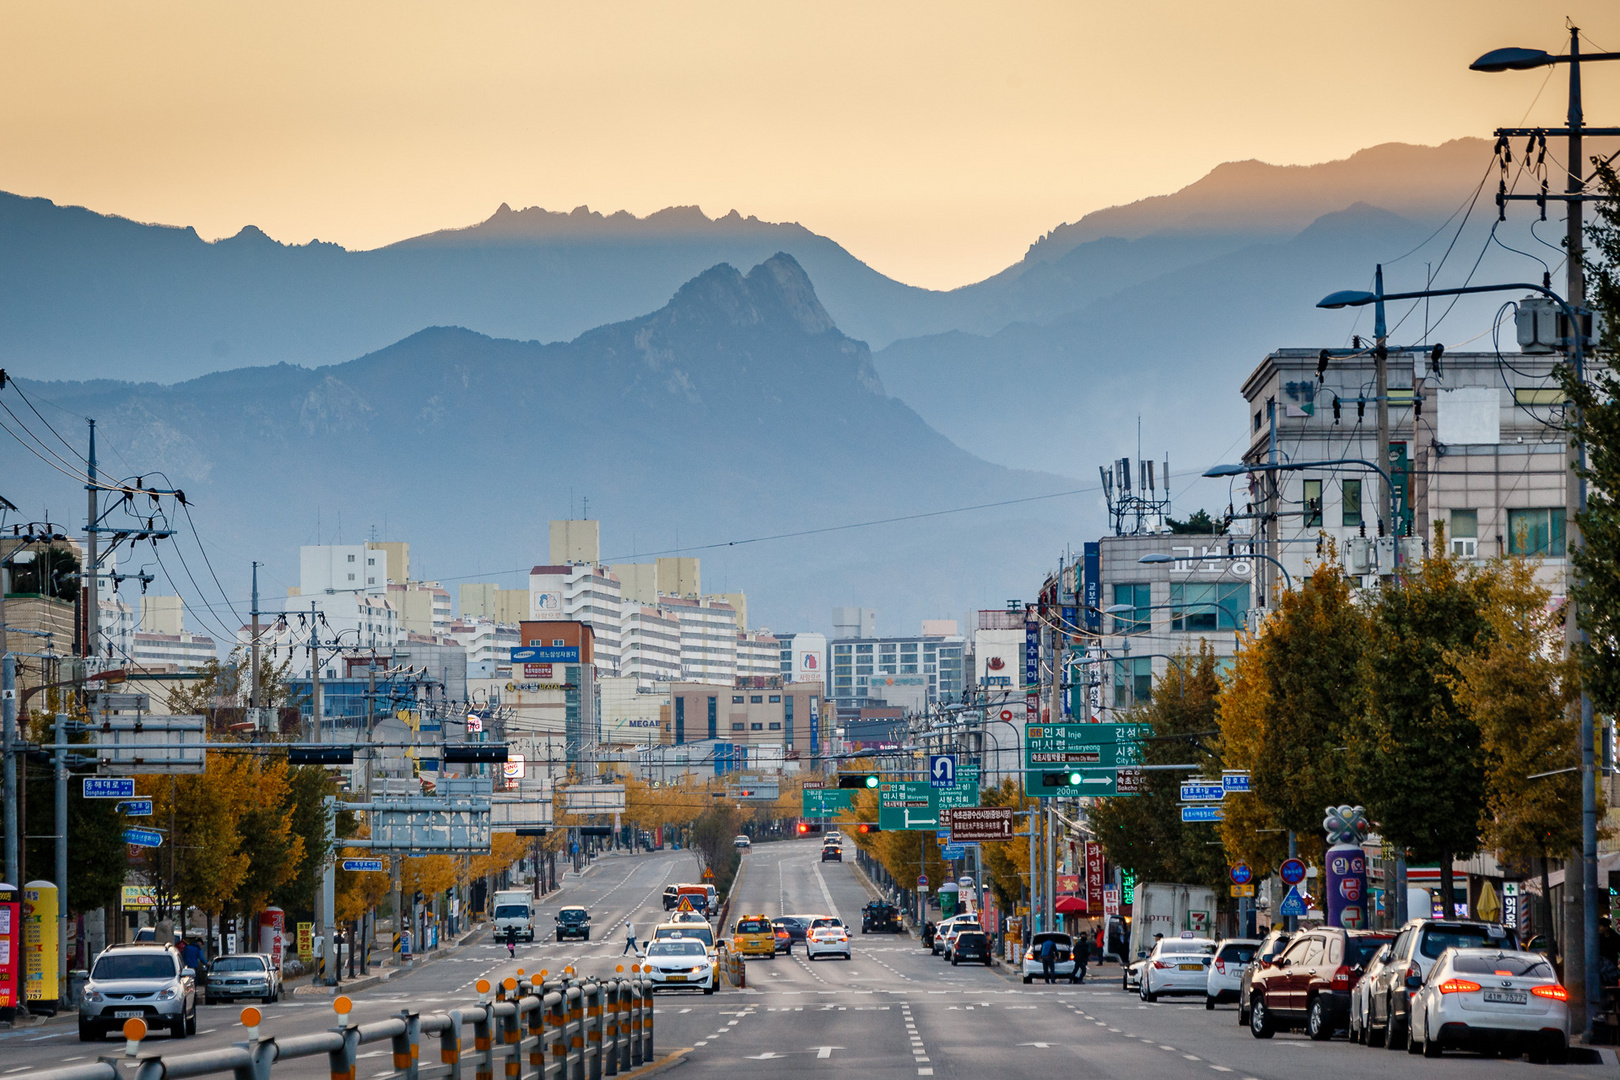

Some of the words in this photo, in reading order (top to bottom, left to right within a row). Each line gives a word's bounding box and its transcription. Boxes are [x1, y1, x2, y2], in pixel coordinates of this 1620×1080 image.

[1027, 633, 1037, 681] 해수피아
[1030, 729, 1042, 737] 56
[1044, 727, 1065, 738] 인제
[1032, 740, 1065, 751] 미시령
[1068, 744, 1100, 752] Misiryeong
[1032, 753, 1066, 762] 속초시립박물관
[86, 781, 119, 790] 동해대로
[1225, 777, 1246, 785] 청호로
[891, 784, 906, 792] 인제
[1057, 788, 1078, 796] 200m
[883, 792, 906, 800] 미시령
[953, 810, 1012, 820] 속초관광수산시장(중앙시장)
[1090, 845, 1102, 900] 과일천국
[1105, 891, 1118, 915] 민박
